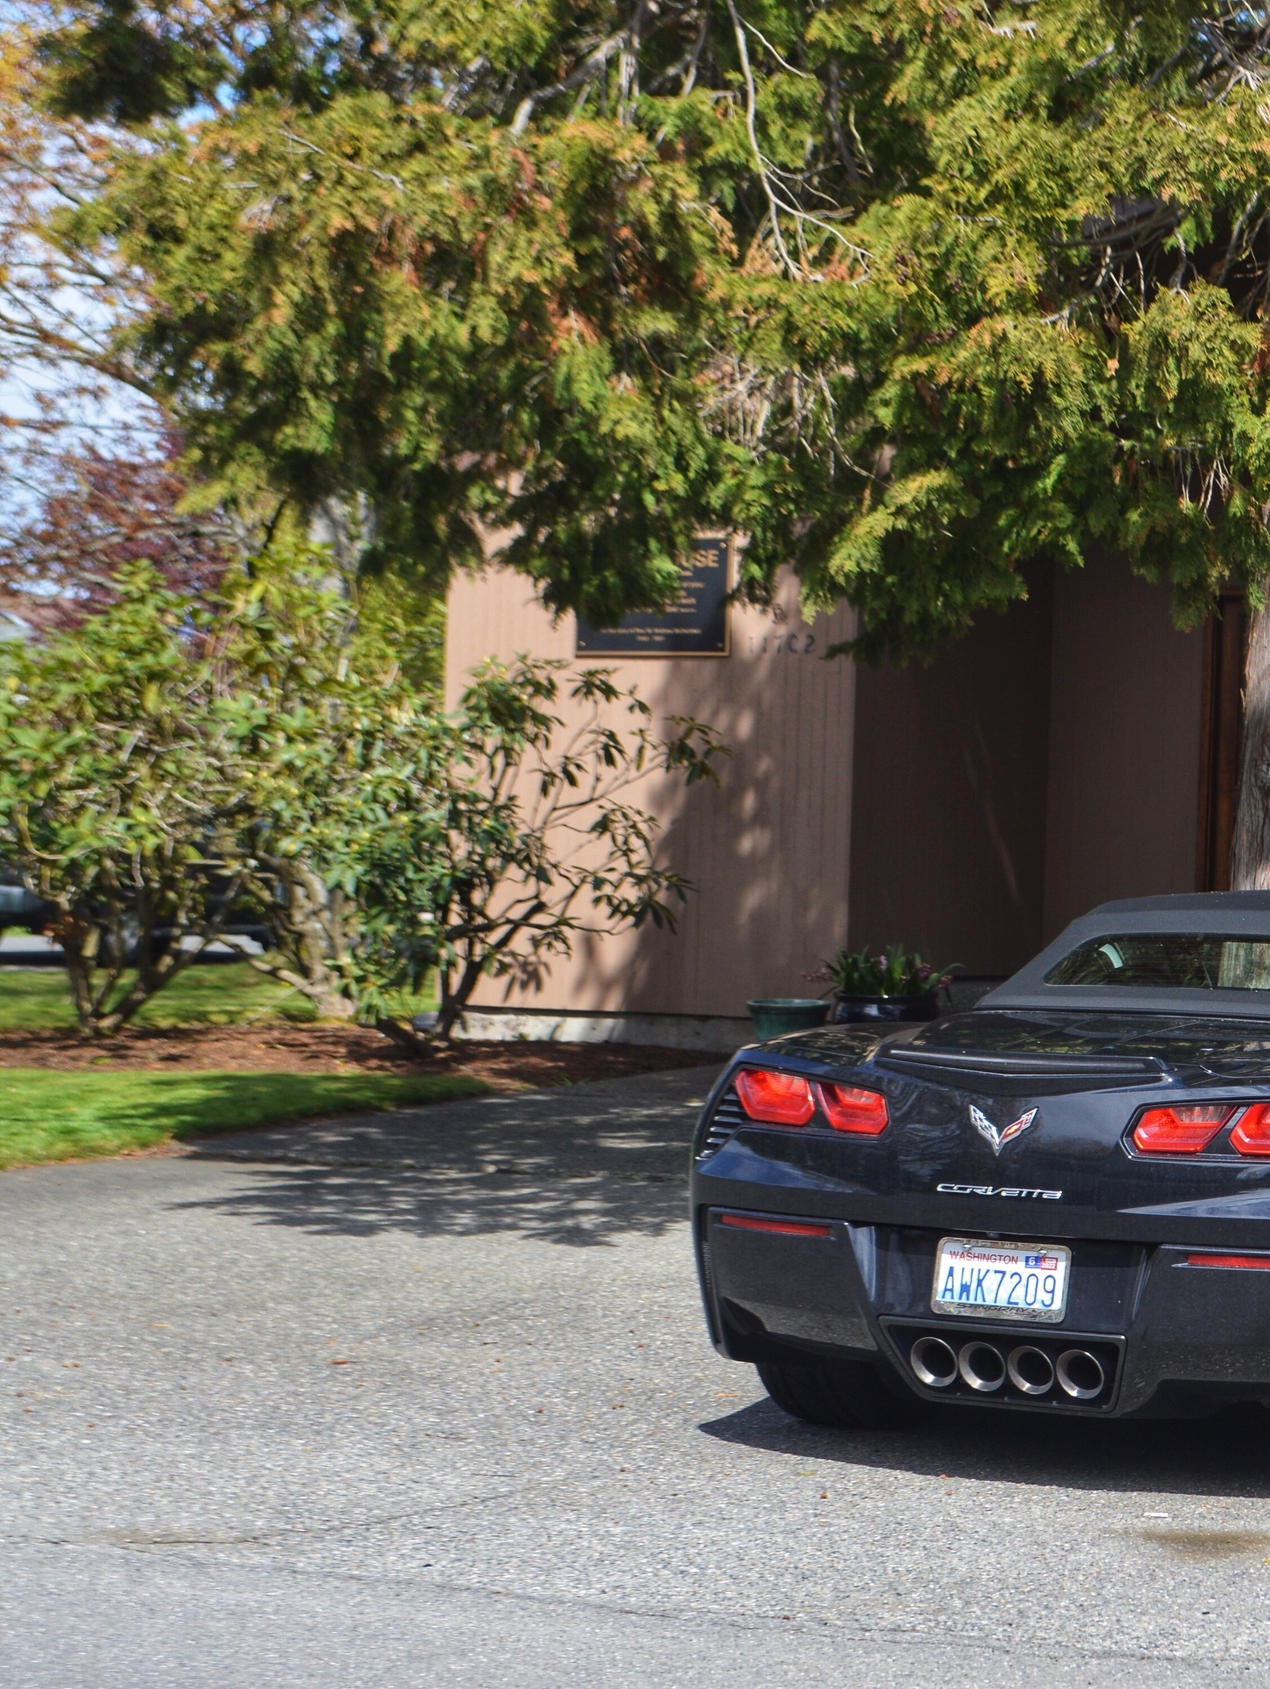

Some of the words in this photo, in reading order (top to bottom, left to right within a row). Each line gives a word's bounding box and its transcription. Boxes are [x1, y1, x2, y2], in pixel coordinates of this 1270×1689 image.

[937, 1184, 1062, 1200] CORVETTE
[949, 1250, 1019, 1265] WASHINGTON
[1029, 1256, 1036, 1266] 6
[941, 1266, 1056, 1308] AWK7209
[955, 1303, 1029, 1314] STINGRAY
